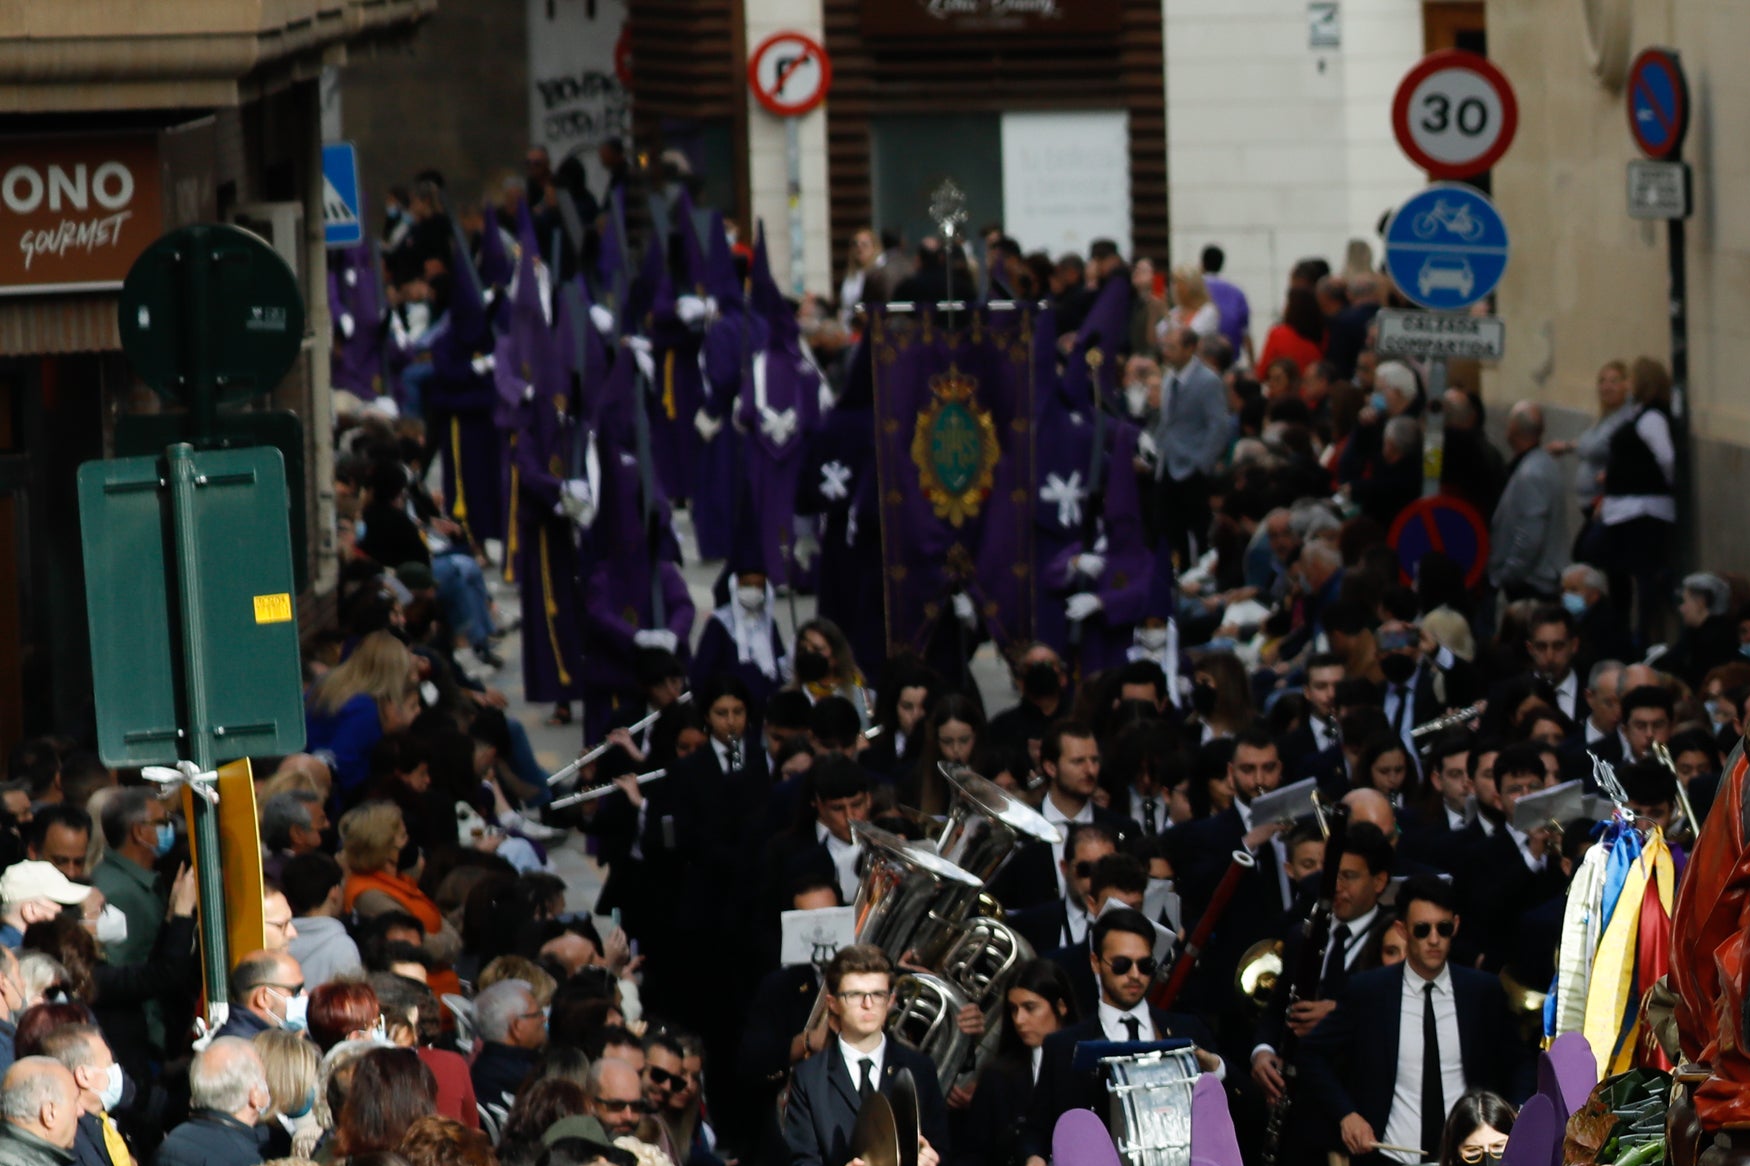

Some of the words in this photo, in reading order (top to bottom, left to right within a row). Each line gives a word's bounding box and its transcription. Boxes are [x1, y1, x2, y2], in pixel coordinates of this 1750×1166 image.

[1421, 92, 1489, 138] 30
[19, 209, 134, 272] GOURMET
[1402, 315, 1480, 335] CALZADA
[1384, 335, 1496, 356] COMPARTIDA
